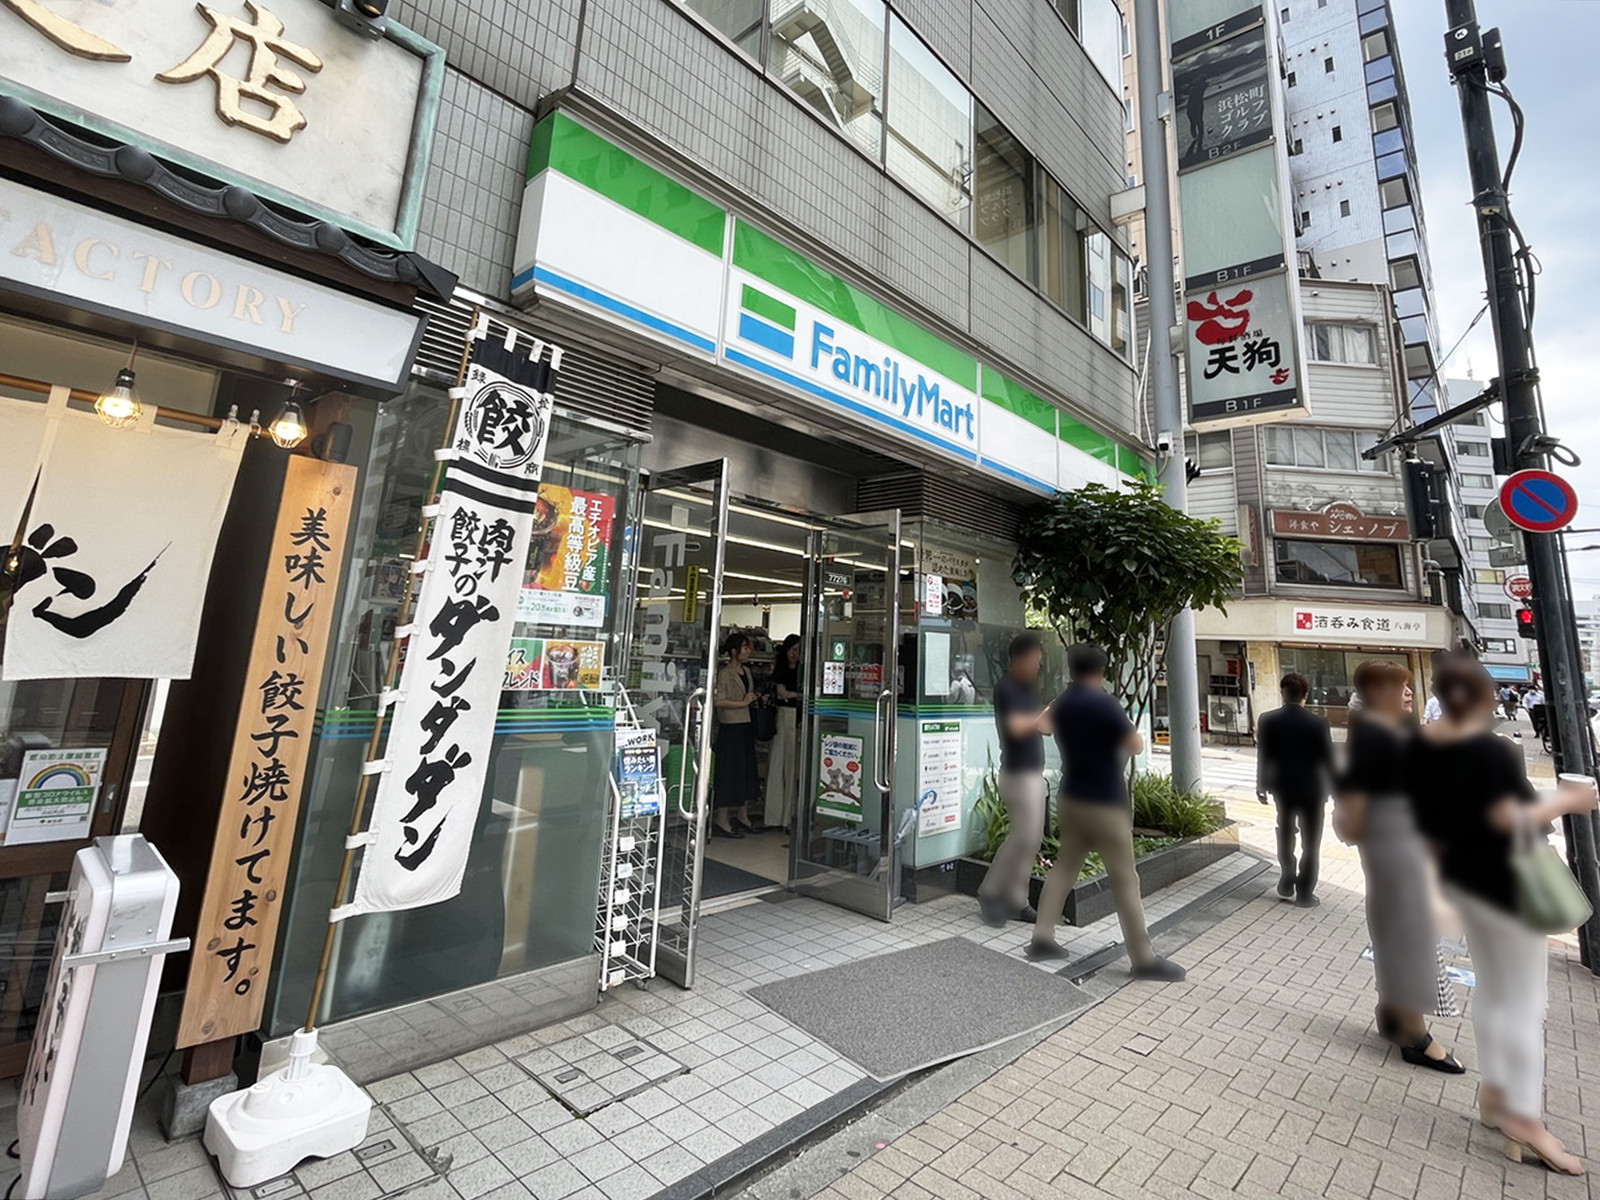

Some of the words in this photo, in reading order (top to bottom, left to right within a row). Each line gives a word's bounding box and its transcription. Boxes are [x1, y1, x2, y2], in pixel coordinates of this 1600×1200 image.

[1206, 24, 1226, 40] 1F
[1218, 84, 1266, 113] 浜松町
[1220, 99, 1265, 124] ゴルフ
[1221, 111, 1268, 139] クラブ
[1208, 142, 1242, 159] B2F
[1217, 266, 1253, 282] B1F
[1203, 337, 1281, 380] 天狗
[810, 320, 974, 440] FamilyMart
[1225, 397, 1263, 412] B1F
[475, 389, 535, 457] 餃
[456, 437, 471, 454] 標
[445, 506, 482, 597] 餃子の
[474, 518, 516, 583] 肉汁
[562, 496, 588, 591] 最高等級豆
[582, 499, 603, 581] エチオピア産
[1314, 614, 1391, 632] 酒呑み食道
[217, 507, 331, 996] 美味しい餃子焼けてます。
[394, 595, 501, 872] ダンダダン
